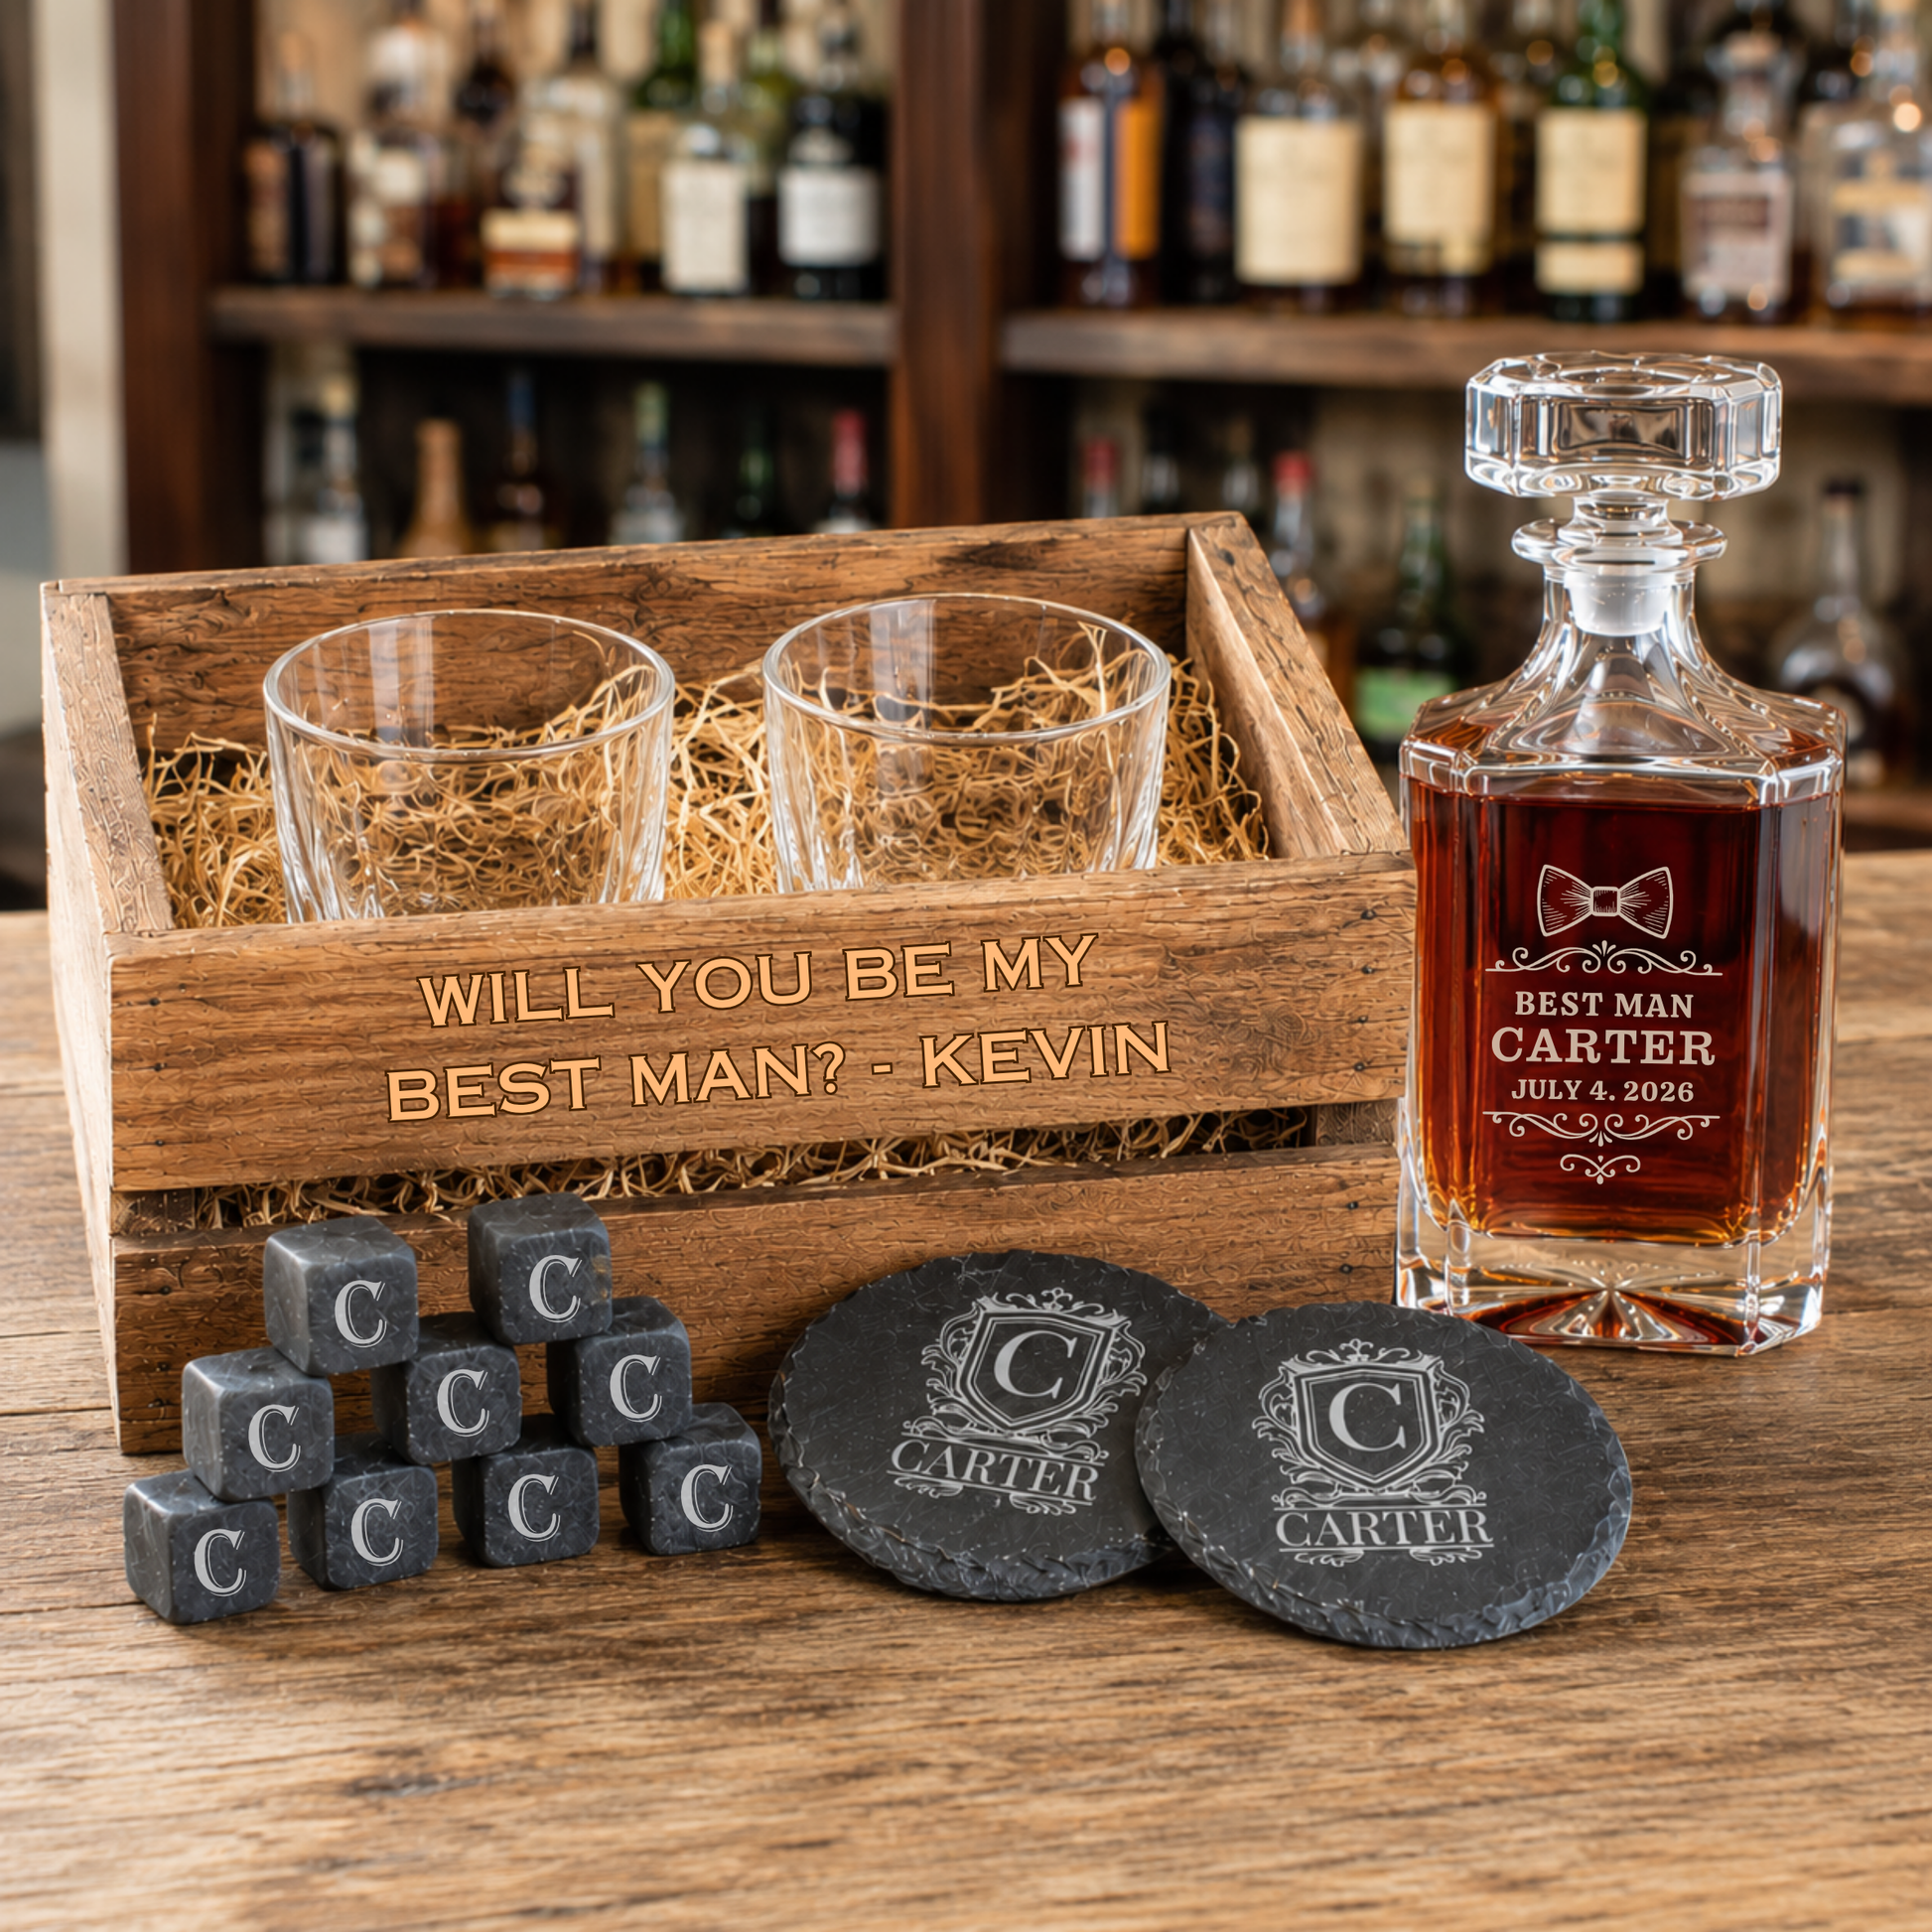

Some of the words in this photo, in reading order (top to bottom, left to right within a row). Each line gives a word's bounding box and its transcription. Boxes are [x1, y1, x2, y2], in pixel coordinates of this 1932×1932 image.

[419, 967, 615, 1027] WILL
[637, 950, 812, 1014] YOU
[843, 941, 953, 1002] BE
[980, 932, 1099, 992] MY
[1515, 991, 1603, 1017] BEST
[1614, 993, 1694, 1019] MAN
[385, 1056, 600, 1122] BEST
[629, 1040, 846, 1108] MAN?
[920, 1020, 1172, 1089] KEVIN
[1491, 1027, 1716, 1066] CARTER
[1511, 1079, 1583, 1101] JULY
[1623, 1081, 1694, 1103] 2026
[335, 1279, 387, 1348] C
[528, 1254, 582, 1323] C
[609, 1353, 662, 1423] C
[993, 1329, 1078, 1399] C
[436, 1368, 489, 1438] C
[1328, 1383, 1408, 1452] C
[247, 1404, 301, 1472] C
[891, 1439, 1100, 1501] CARTER
[350, 1498, 404, 1567] C
[507, 1473, 561, 1543] C
[680, 1463, 734, 1533] C
[1275, 1509, 1493, 1548] CARTER
[194, 1529, 247, 1597] C
